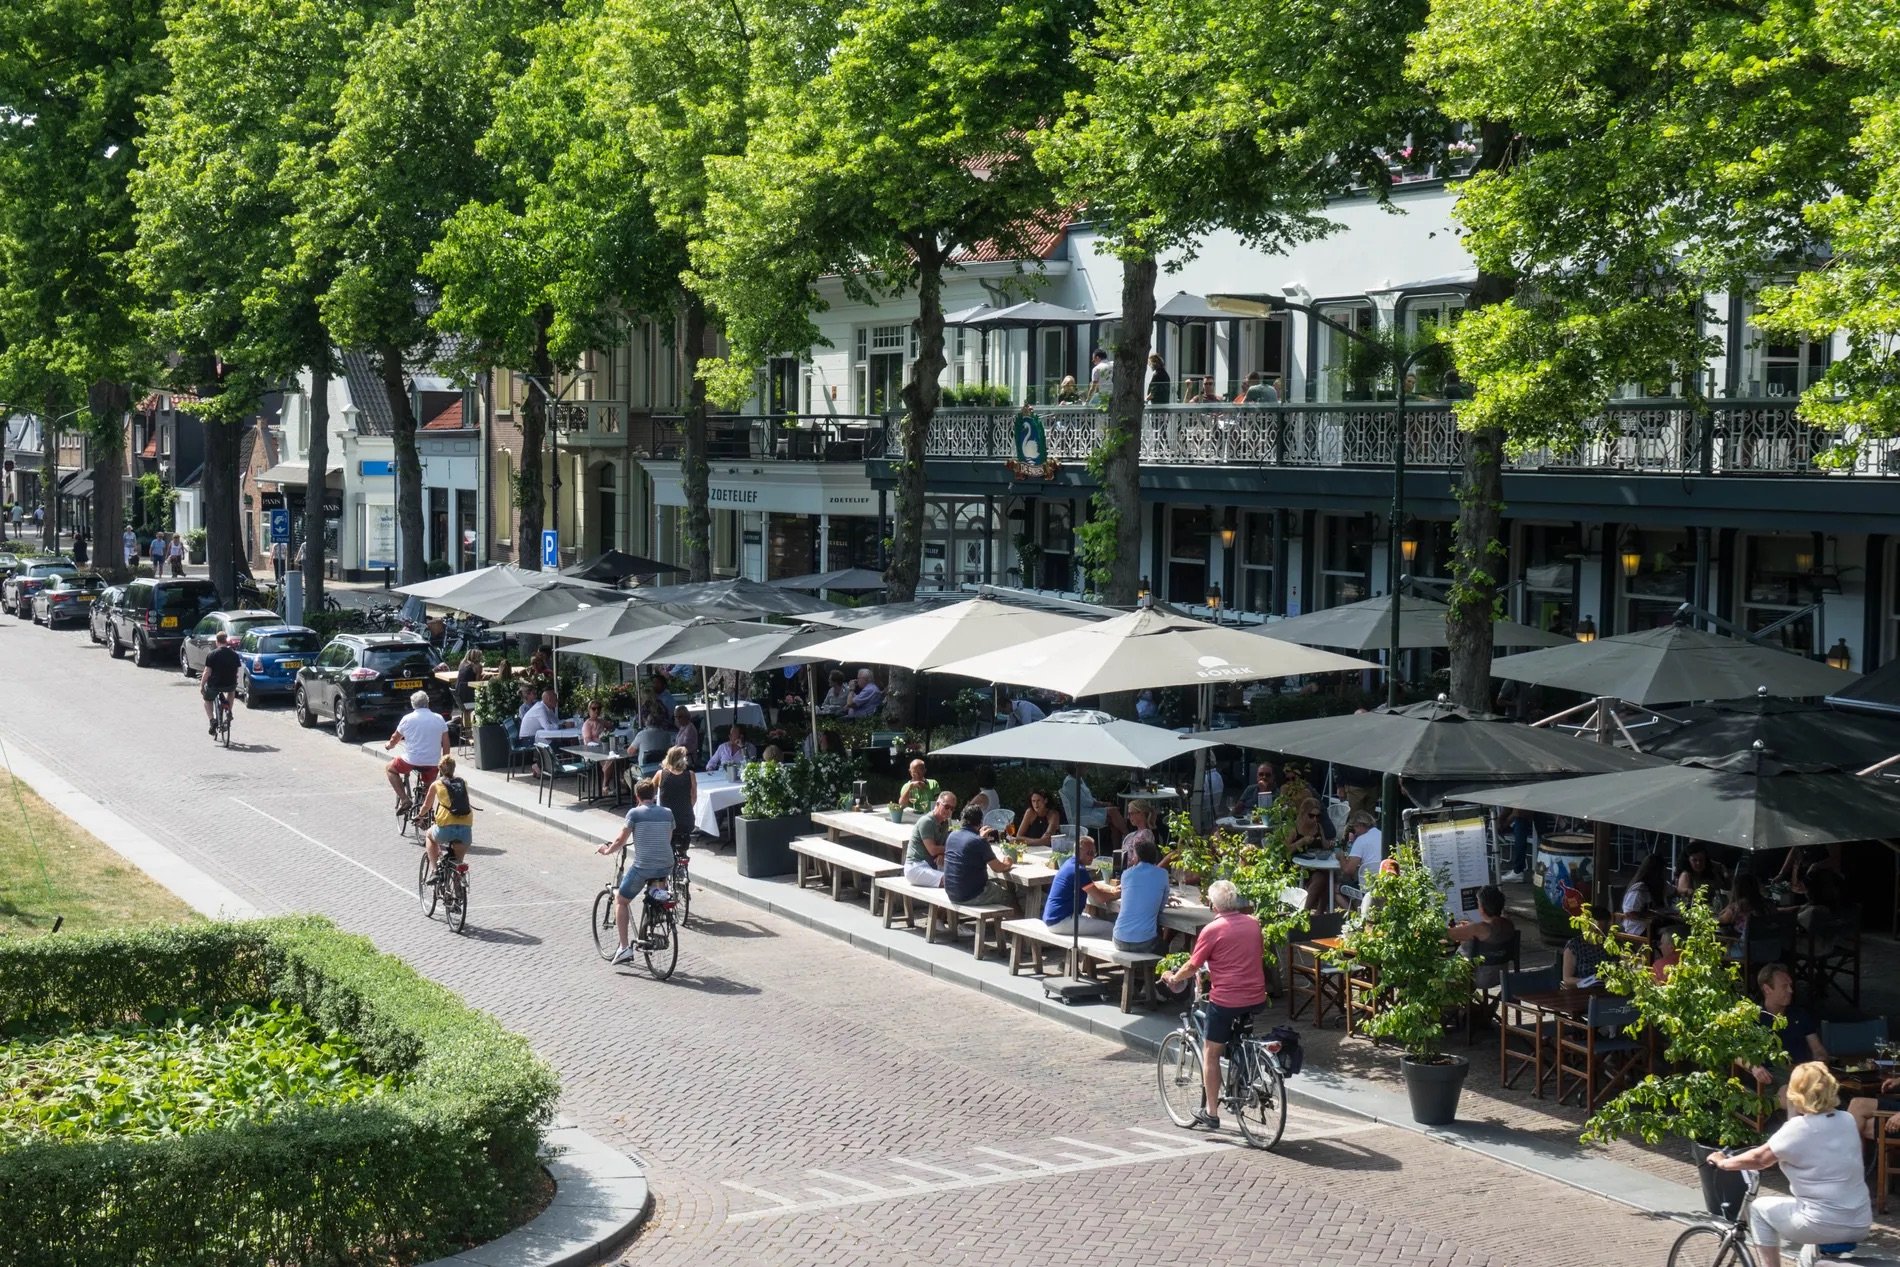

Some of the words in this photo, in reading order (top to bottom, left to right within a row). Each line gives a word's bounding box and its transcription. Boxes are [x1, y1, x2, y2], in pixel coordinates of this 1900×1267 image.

[711, 488, 758, 503] ZOETELIEF
[545, 535, 554, 562] P
[1195, 667, 1255, 678] BOREK
